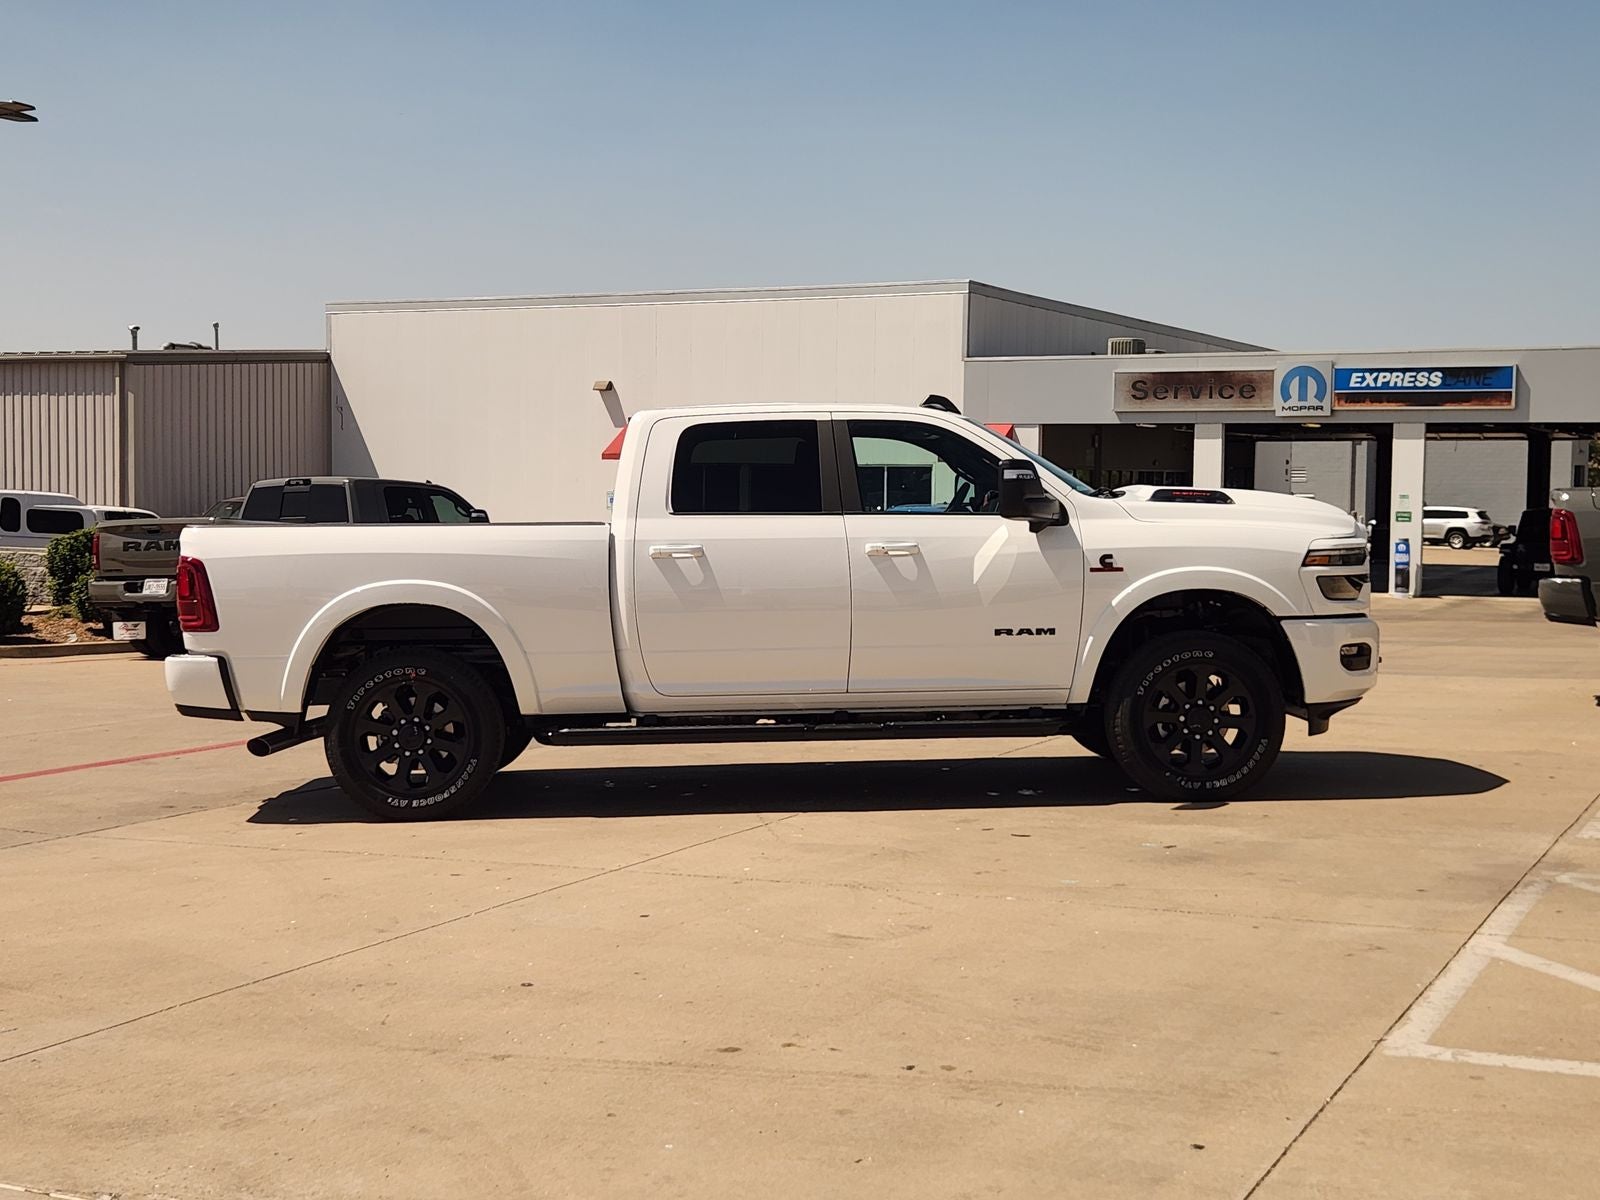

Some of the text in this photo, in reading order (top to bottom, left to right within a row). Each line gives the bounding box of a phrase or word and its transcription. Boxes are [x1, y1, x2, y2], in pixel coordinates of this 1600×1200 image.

[1349, 371, 1443, 387] EXPRESS
[1130, 378, 1257, 400] Service
[1281, 404, 1325, 412] MOPAR
[122, 541, 181, 552] RAM
[994, 627, 1056, 636] RAM
